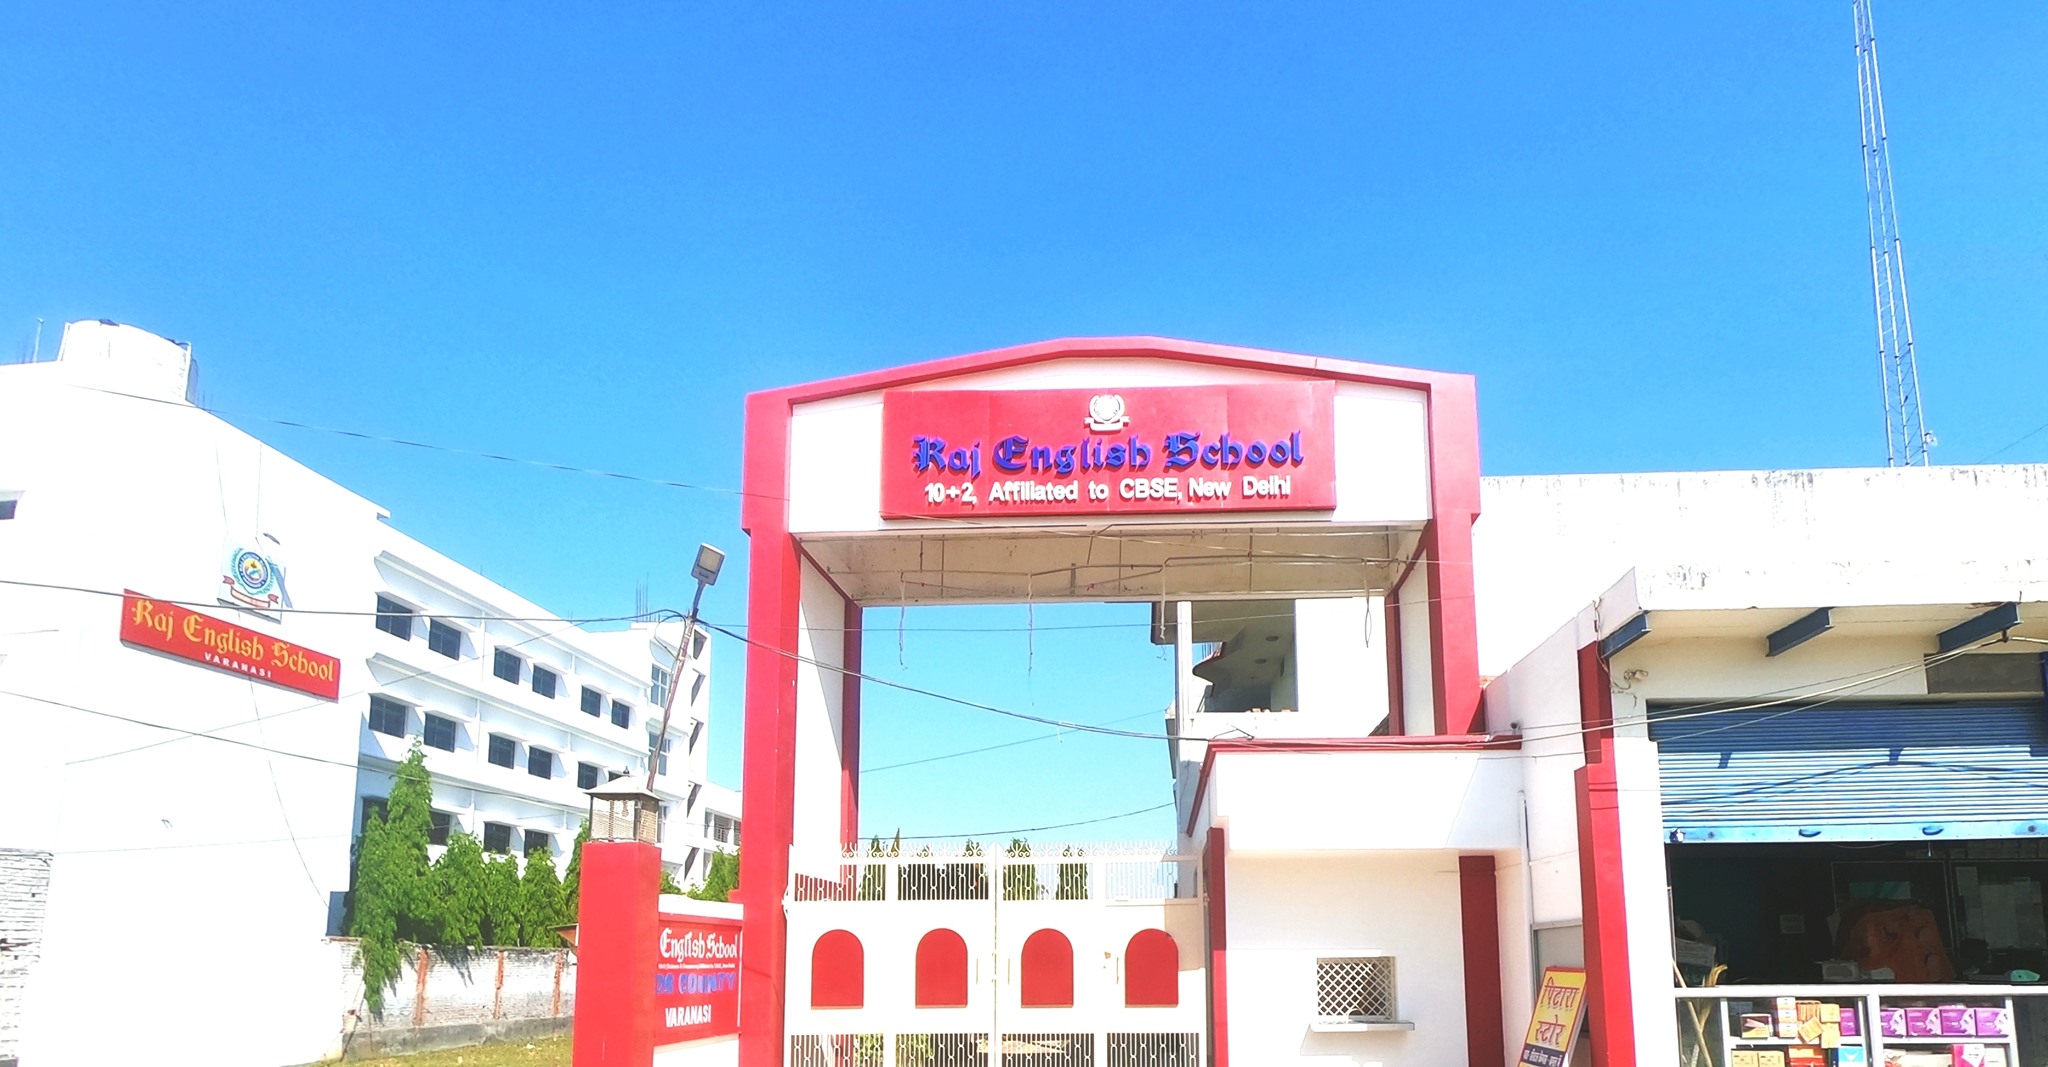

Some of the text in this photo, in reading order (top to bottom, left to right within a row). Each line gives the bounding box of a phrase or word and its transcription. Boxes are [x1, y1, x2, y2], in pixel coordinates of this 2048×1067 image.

[913, 430, 1304, 478] Raj English School
[924, 474, 1291, 504] 10+2, Affiliated to CBSE, New Delhi
[131, 599, 334, 682] Raj English School
[204, 652, 272, 679] VARANASI
[660, 927, 738, 962] English School
[665, 1004, 712, 1028] VARANASI
